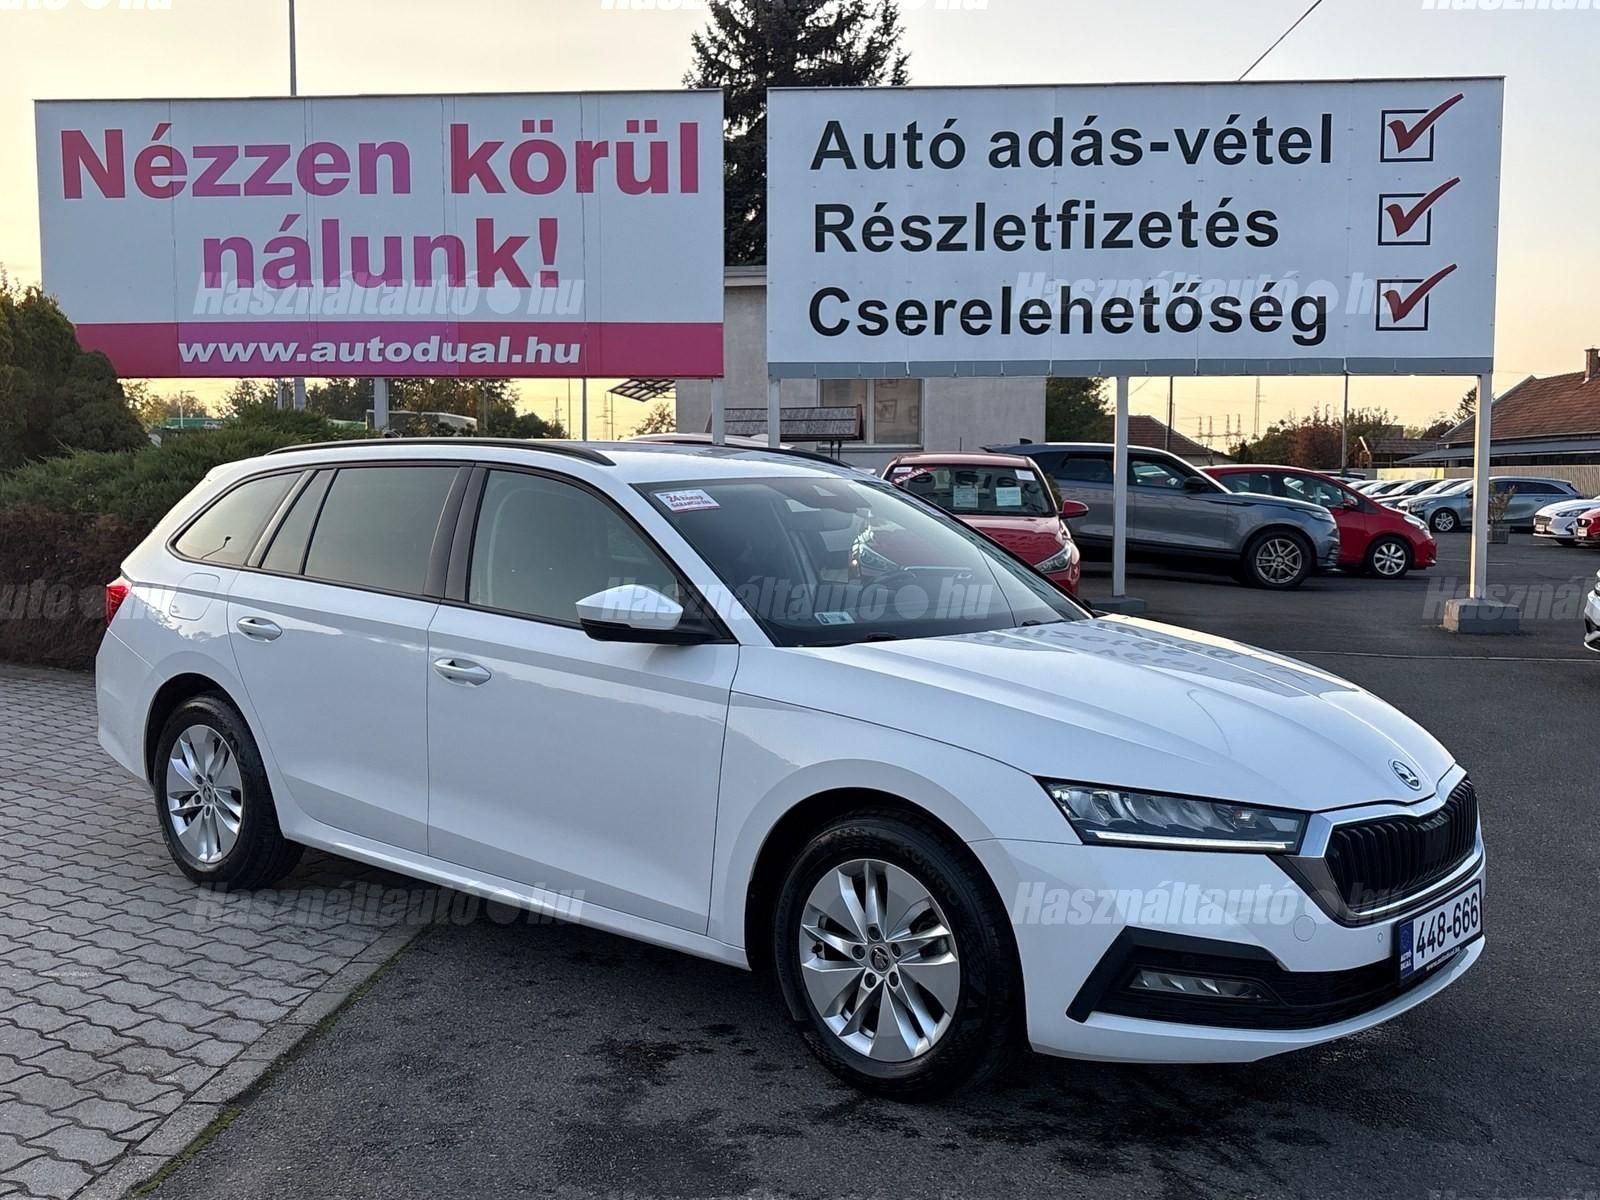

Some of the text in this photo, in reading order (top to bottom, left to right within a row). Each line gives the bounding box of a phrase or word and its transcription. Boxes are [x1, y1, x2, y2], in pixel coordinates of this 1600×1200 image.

[60, 119, 699, 200] Nézzen körül
[810, 113, 1333, 171] Autó adás-vétel
[203, 213, 560, 290] nálunk!
[813, 196, 1280, 254] Részletfizetés
[808, 281, 1329, 347] Cserelehetőség
[178, 335, 581, 364] www.autodual.hu
[1416, 891, 1479, 959] 448-666
